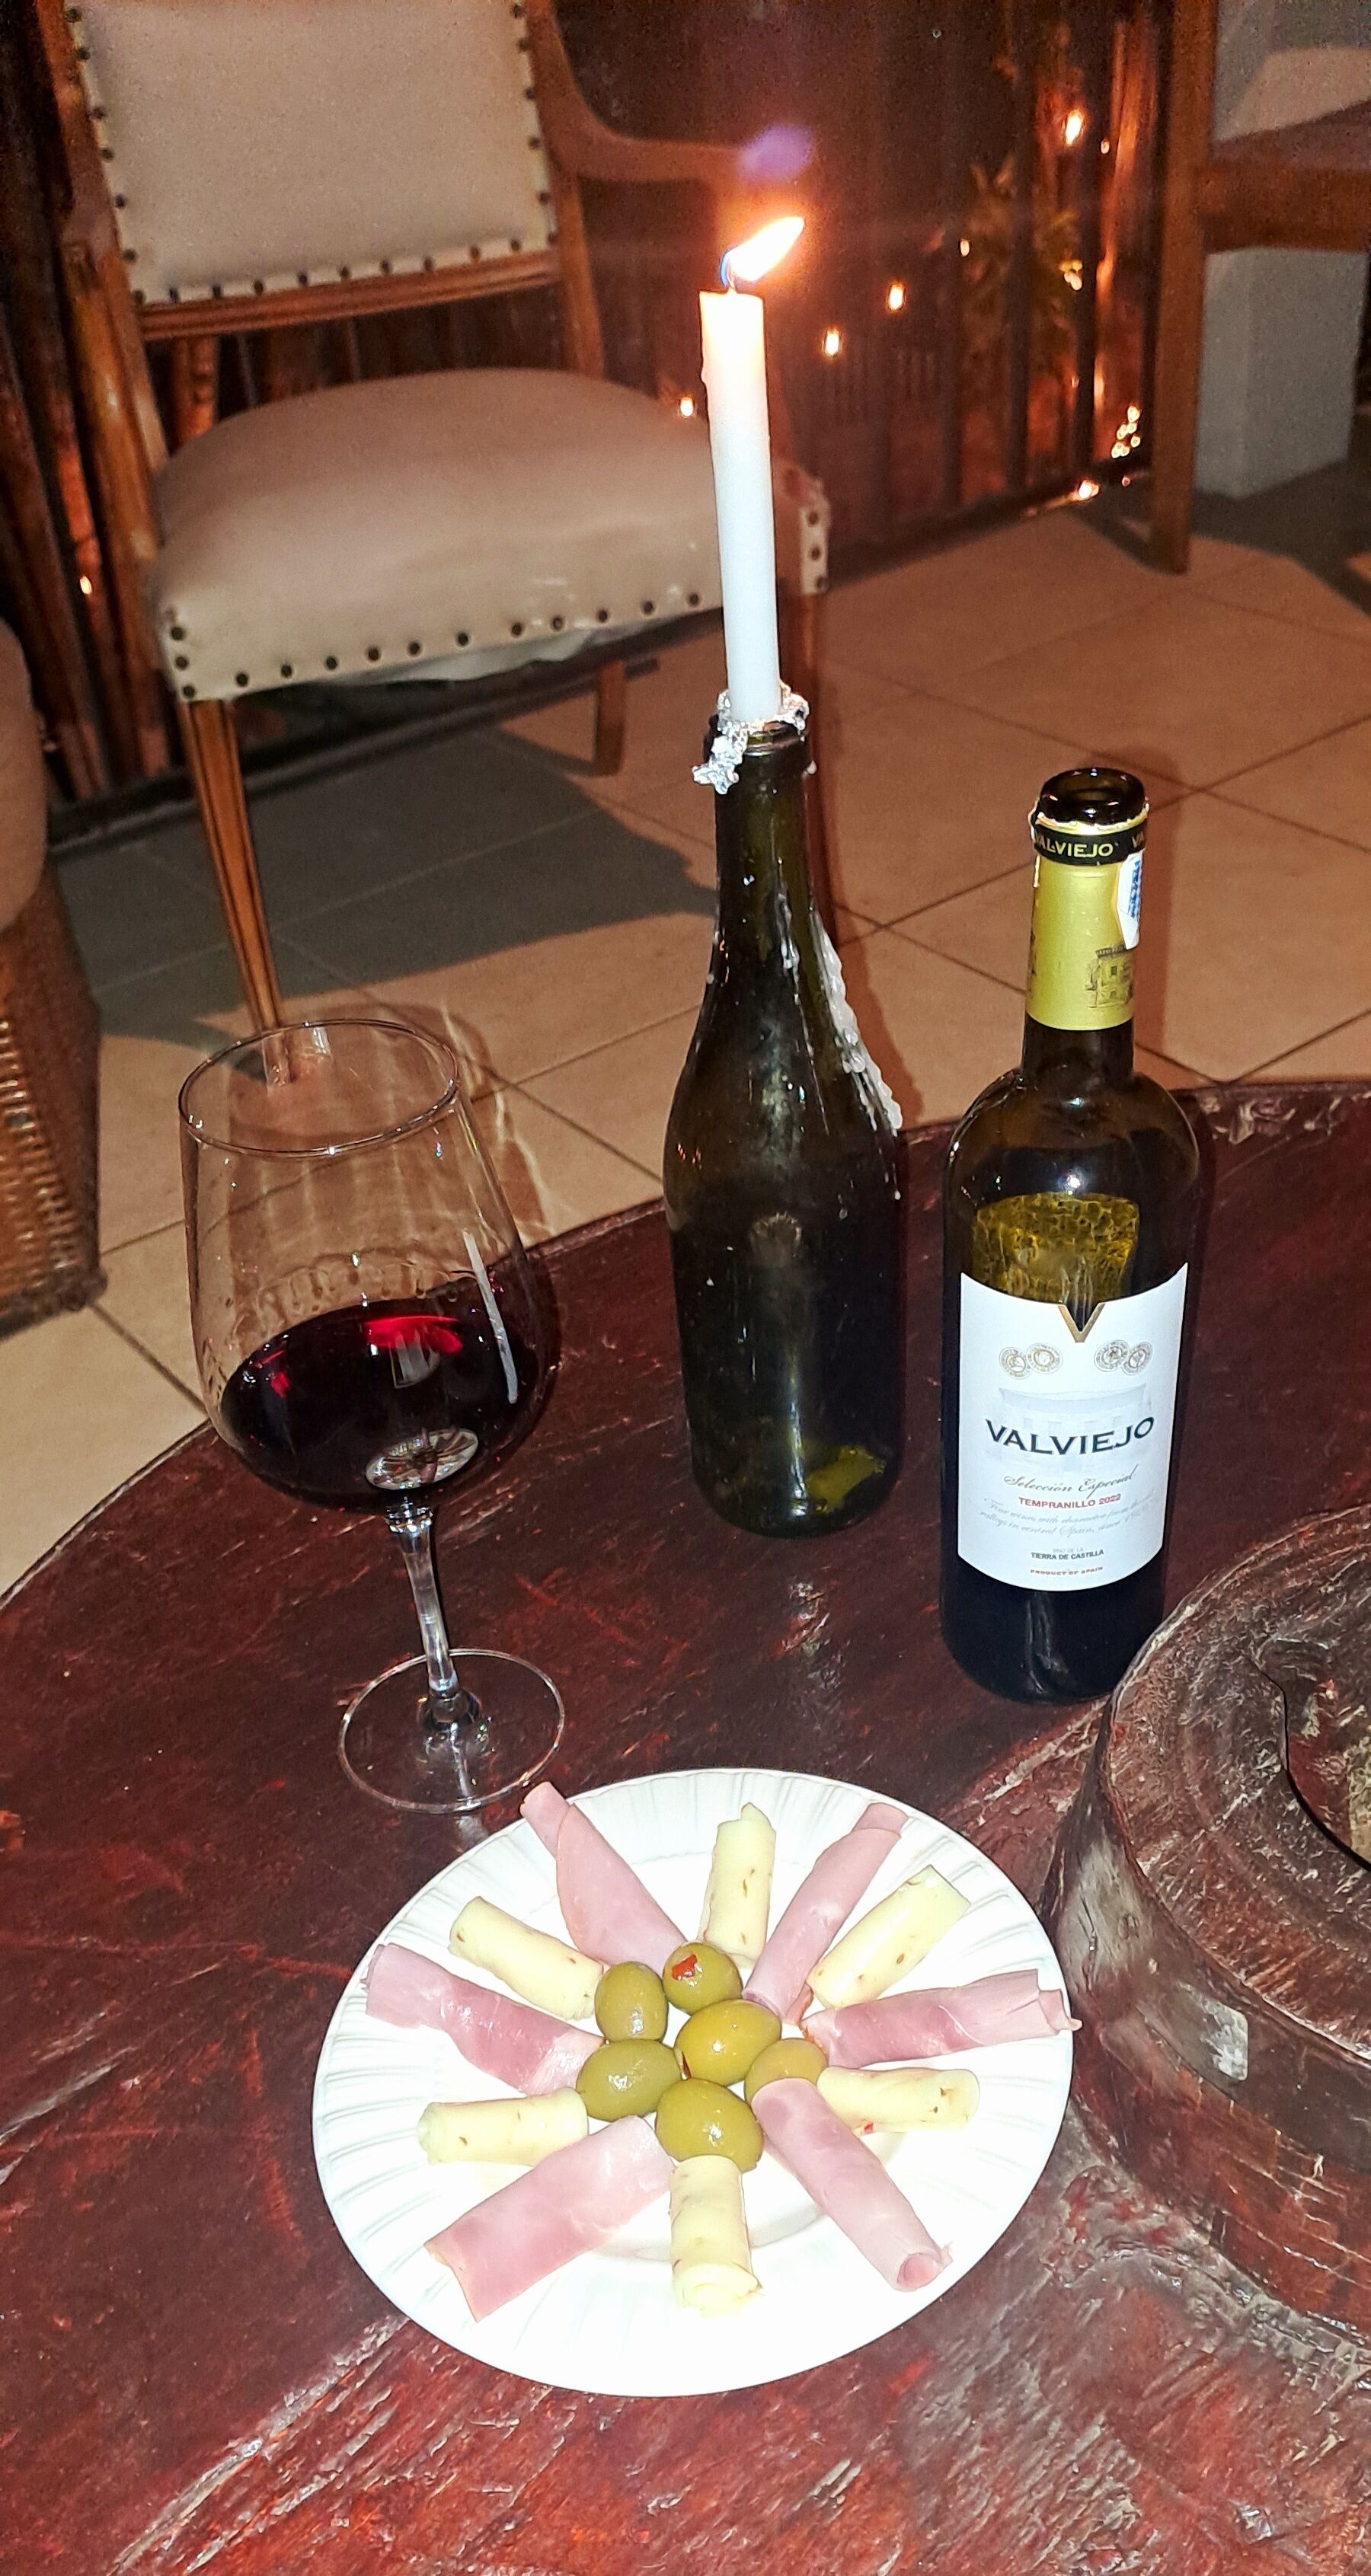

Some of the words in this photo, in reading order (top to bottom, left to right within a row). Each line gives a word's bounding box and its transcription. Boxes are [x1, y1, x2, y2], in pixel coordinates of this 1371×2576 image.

[985, 1416, 1155, 1455] VALVIEJO
[1003, 1475, 1072, 1492] Selección
[1078, 1464, 1139, 1499] Especial
[1018, 1496, 1095, 1509] TEMPRANILLO
[1098, 1493, 1121, 1505] 2022
[1031, 1552, 1056, 1560] TIERRA
[1071, 1549, 1104, 1559] CASTILLA
